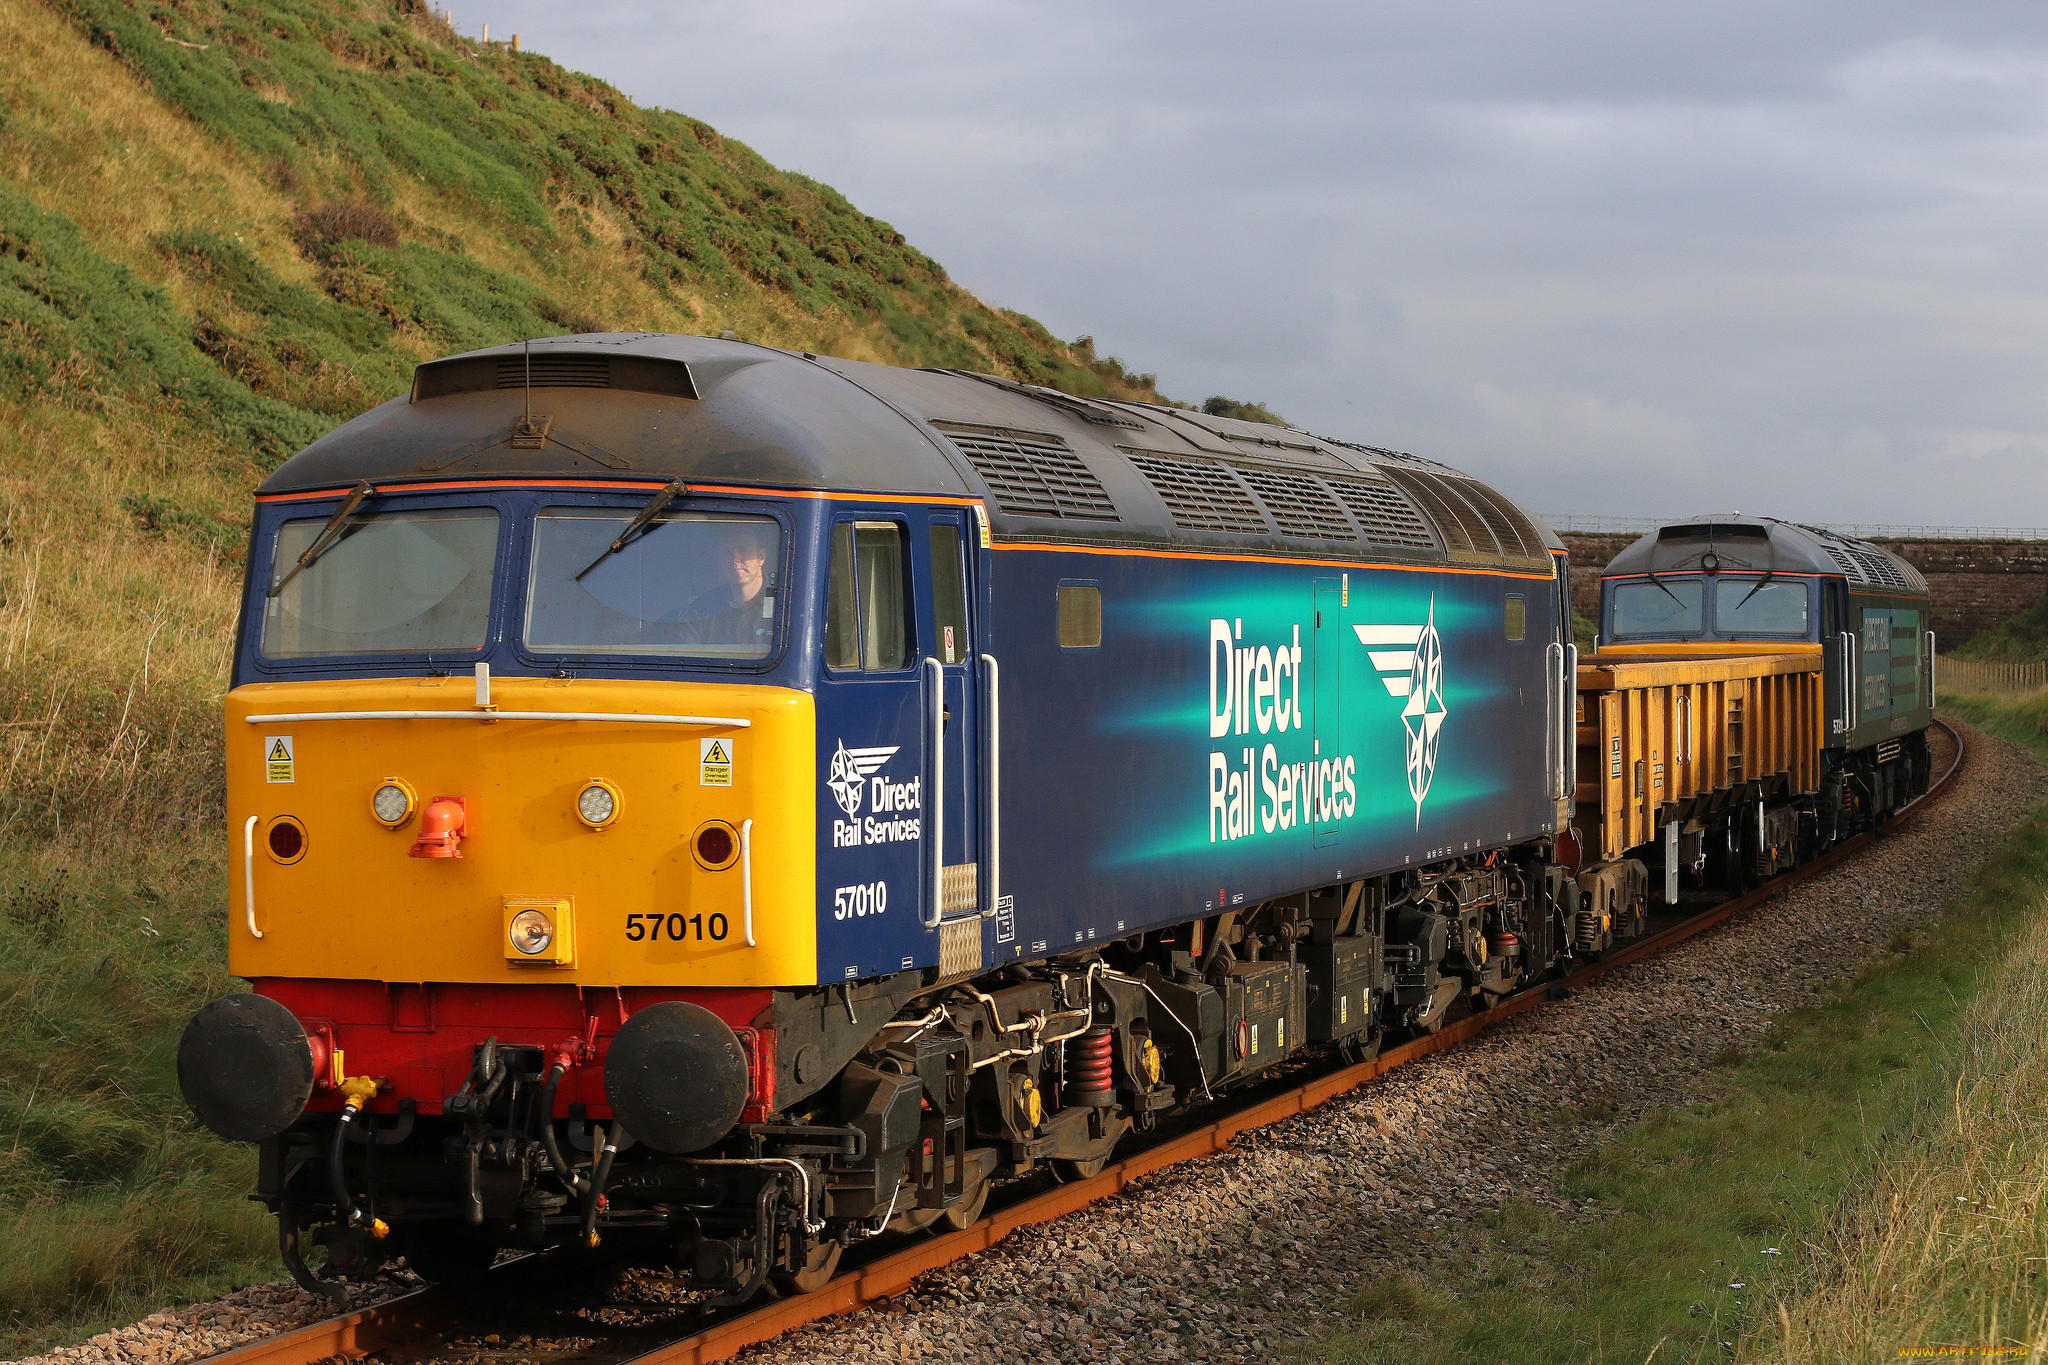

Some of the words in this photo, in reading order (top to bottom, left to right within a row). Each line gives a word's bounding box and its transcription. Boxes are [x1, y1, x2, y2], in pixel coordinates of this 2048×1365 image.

[1209, 617, 1302, 738] Direct
[871, 775, 921, 813] Direct
[1209, 747, 1256, 843] Rail
[1260, 739, 1357, 834] Services
[833, 817, 862, 848] Rail
[864, 814, 920, 845] Services
[834, 880, 887, 921] 57010
[625, 912, 728, 941] 57010
